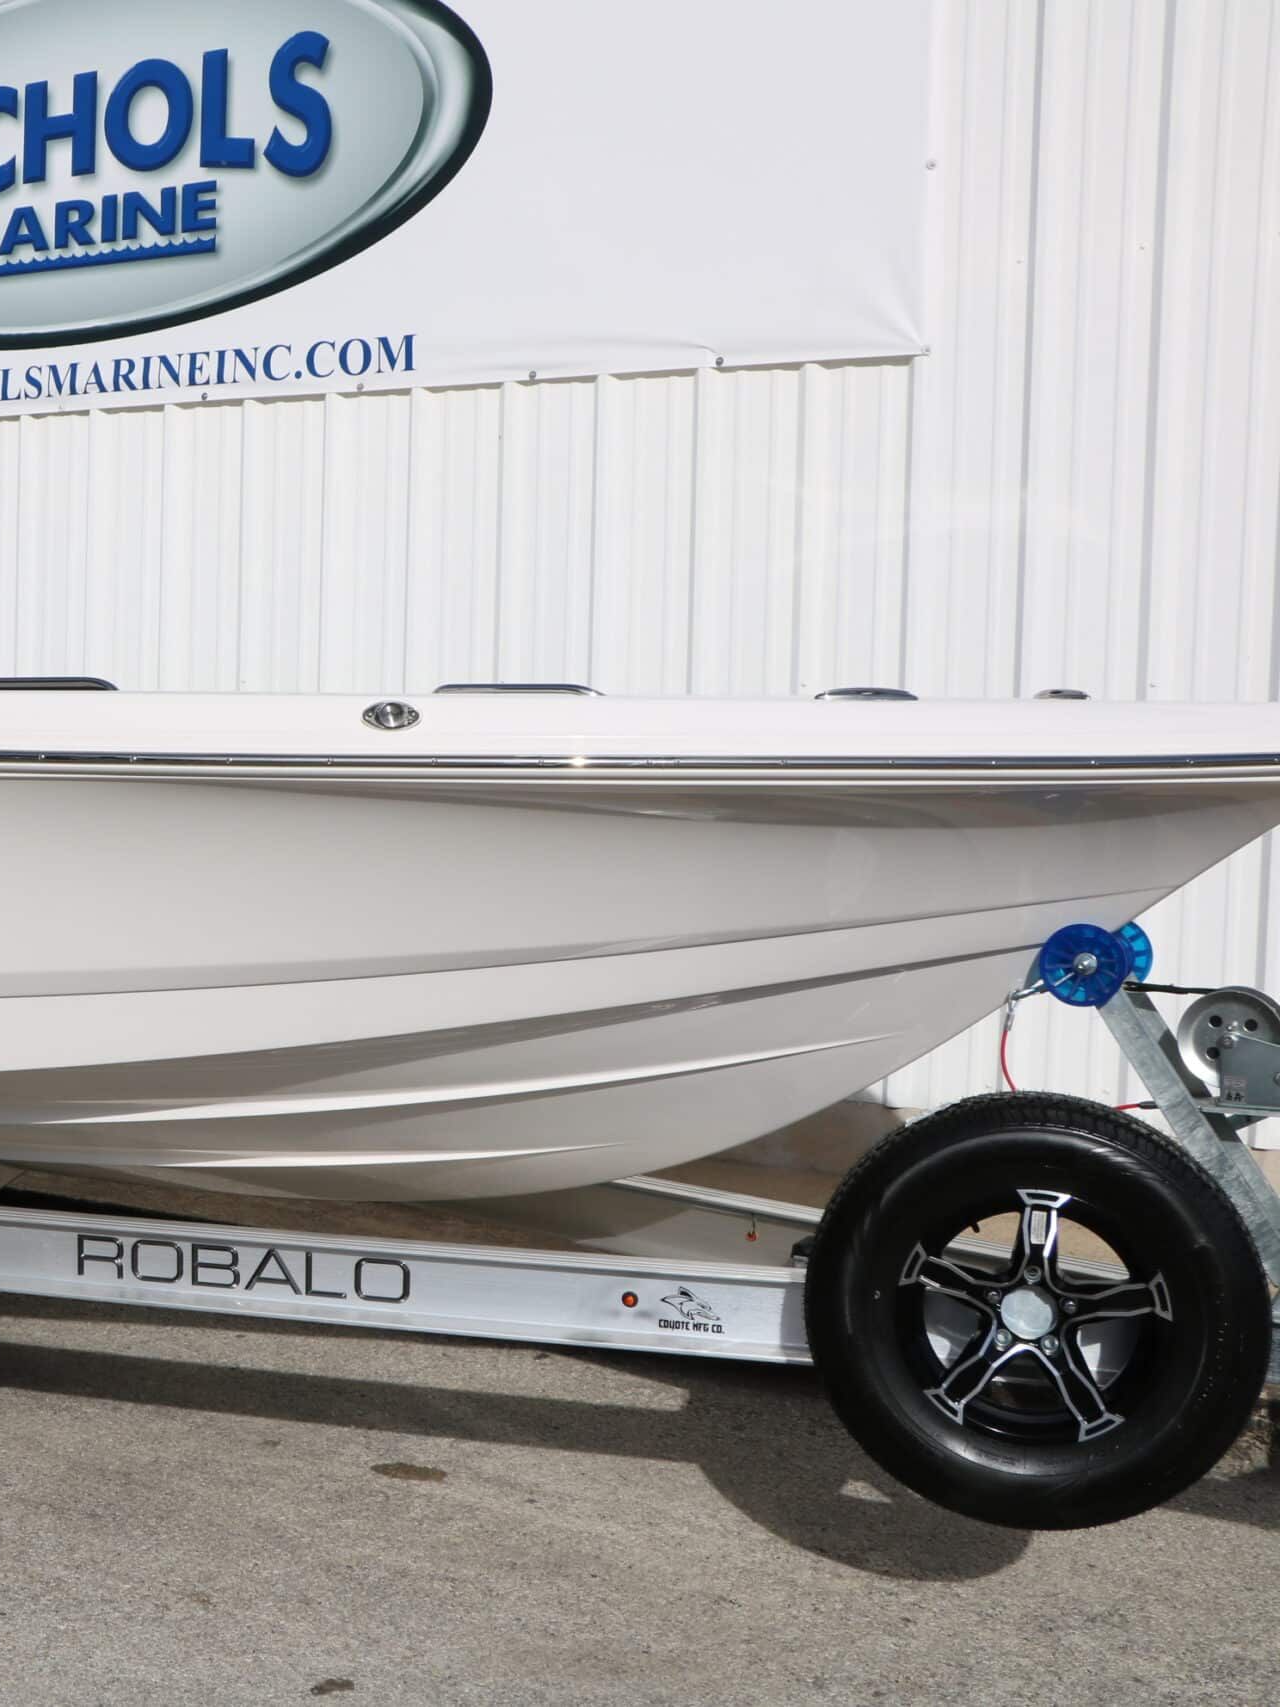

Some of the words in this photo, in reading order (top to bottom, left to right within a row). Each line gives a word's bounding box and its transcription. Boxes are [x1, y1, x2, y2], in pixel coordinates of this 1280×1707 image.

[76, 1234, 411, 1304] ROBALO
[658, 1319, 690, 1331] COYOTE
[692, 1321, 709, 1332] MFG
